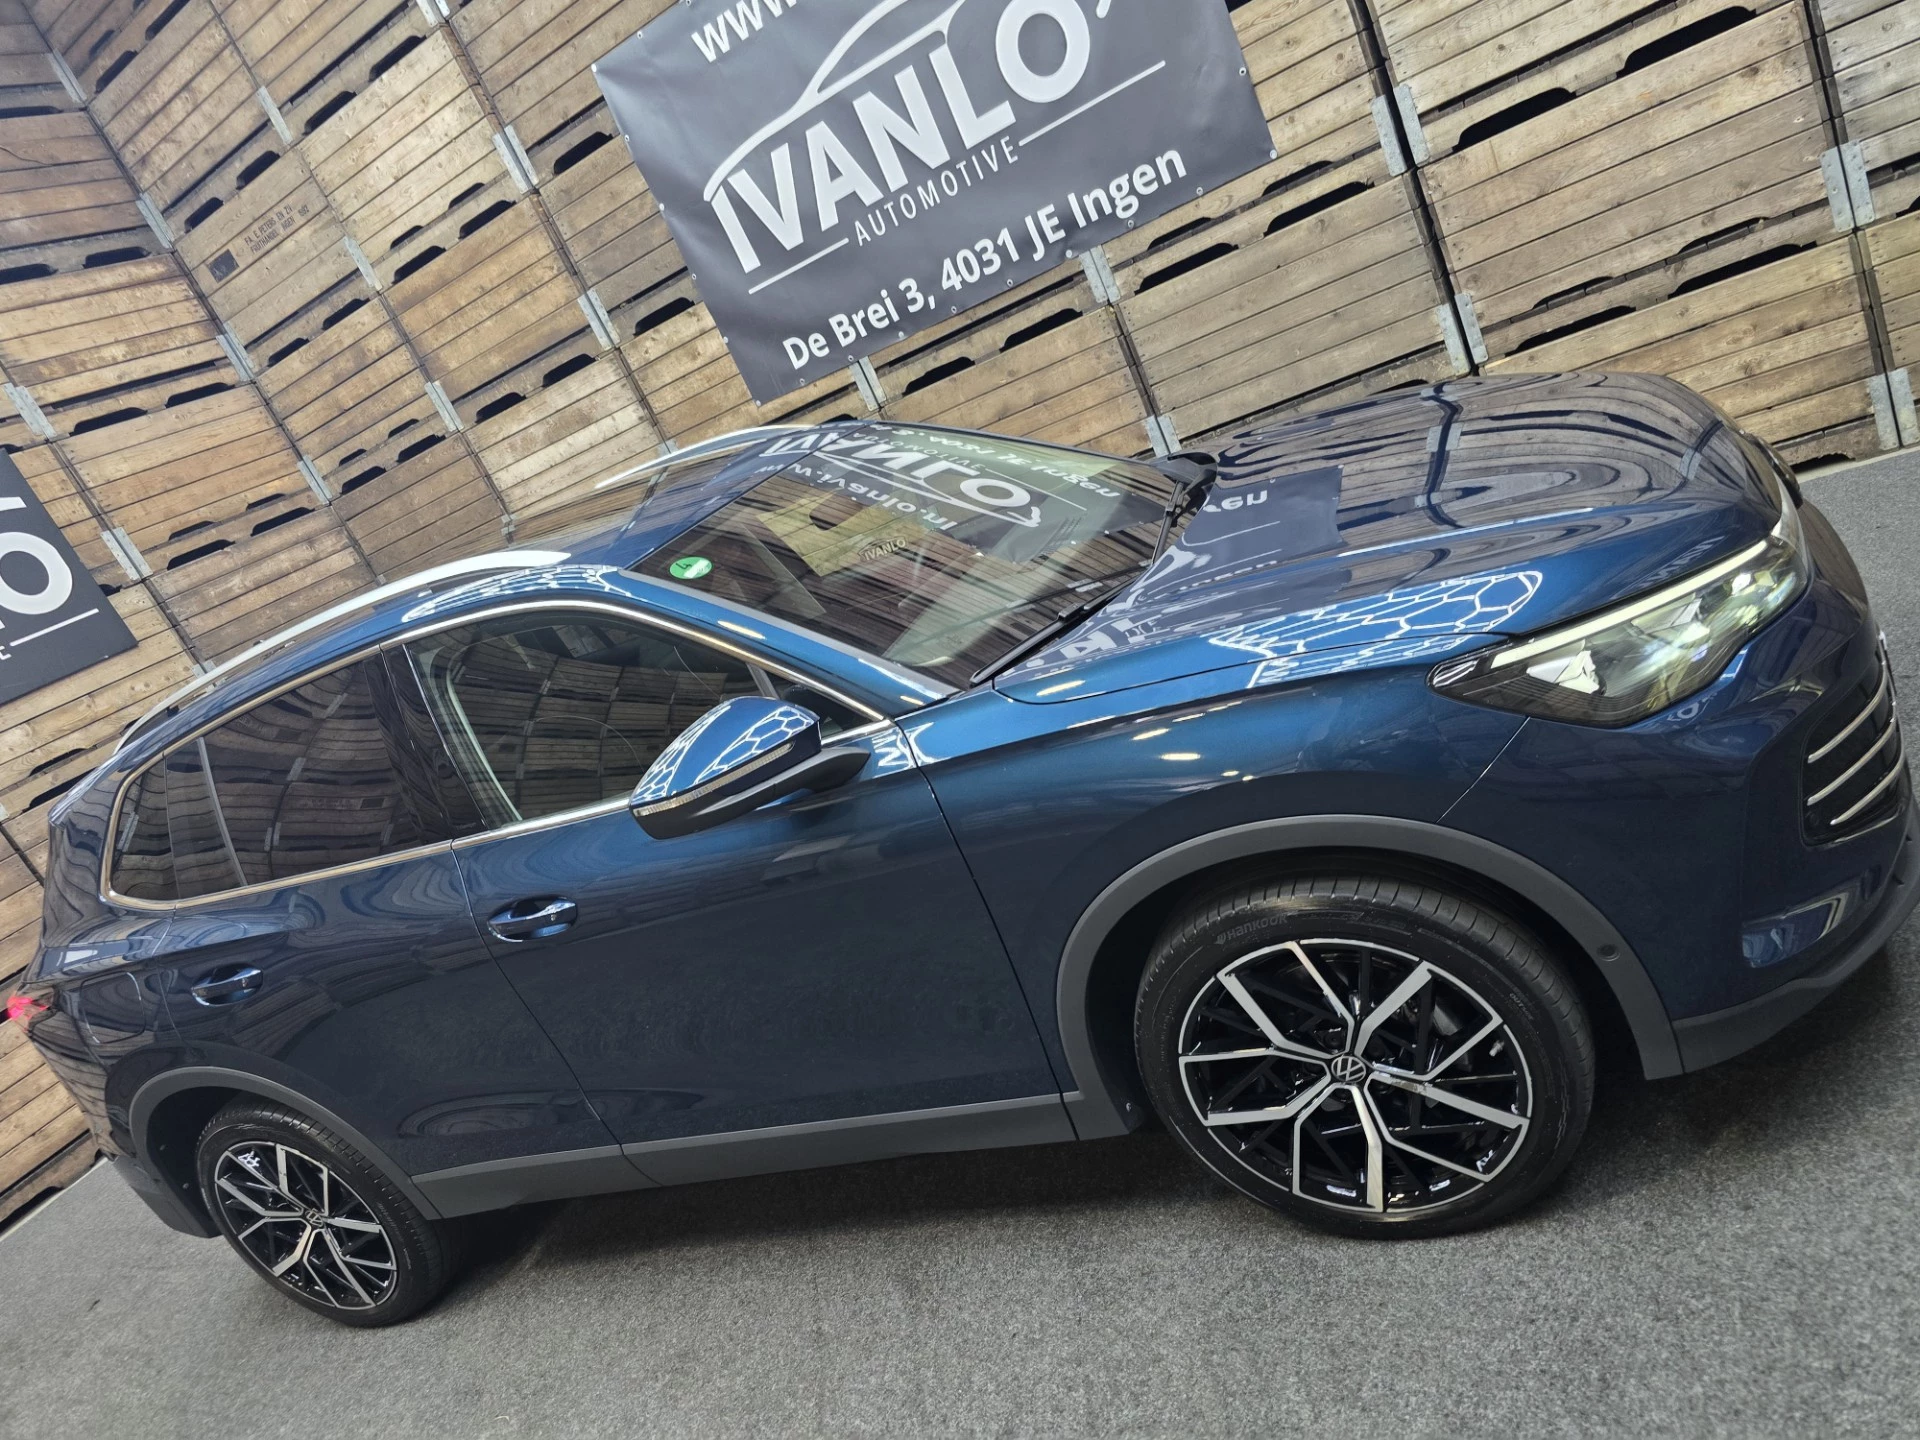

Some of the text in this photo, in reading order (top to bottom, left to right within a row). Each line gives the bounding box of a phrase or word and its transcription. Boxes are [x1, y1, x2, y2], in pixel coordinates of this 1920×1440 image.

[711, 0, 1090, 274] IVANLO
[854, 135, 1018, 247] AUTOMOTIVE
[782, 149, 1187, 370] De Brei 3, 4031 JE Ingen
[864, 538, 906, 562] IVANLO
